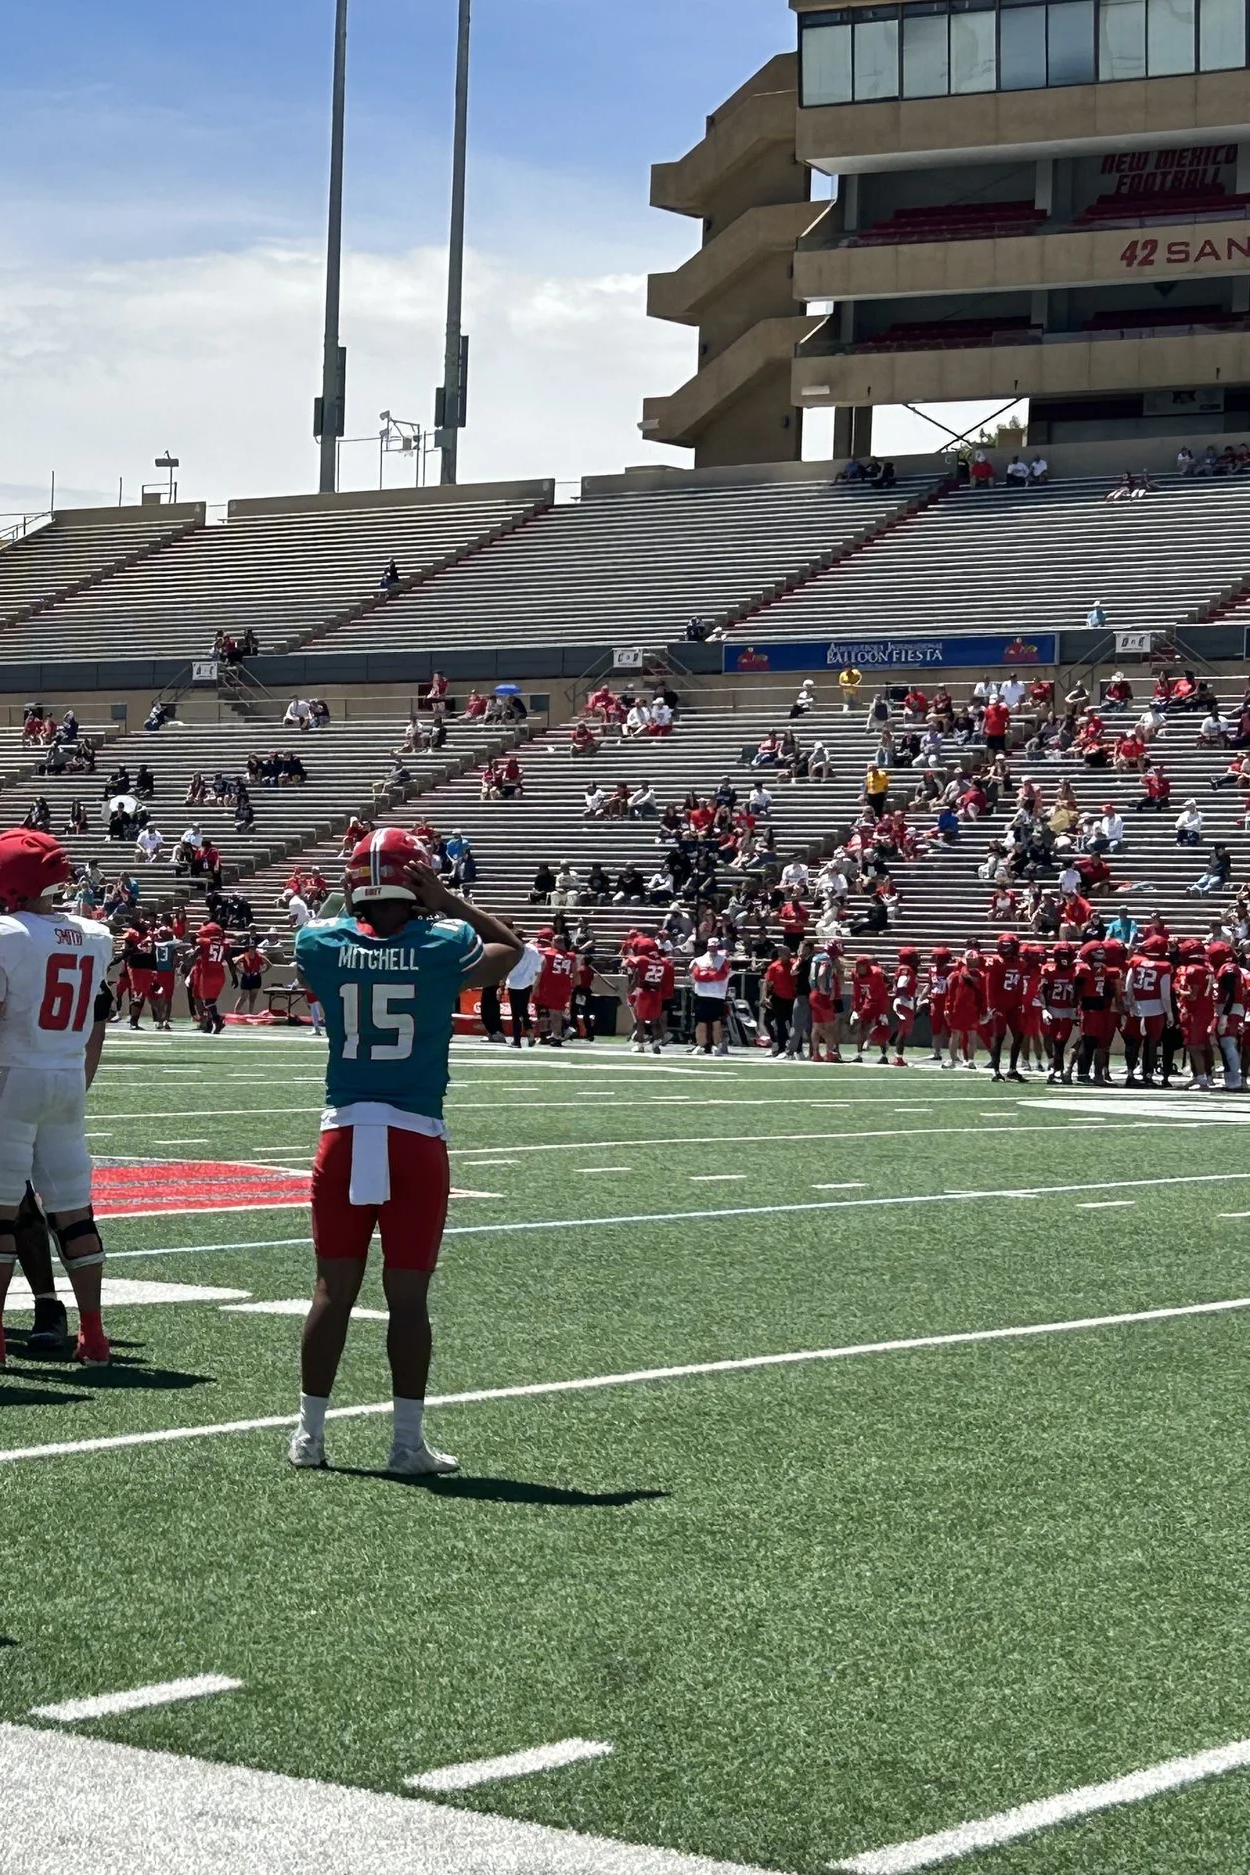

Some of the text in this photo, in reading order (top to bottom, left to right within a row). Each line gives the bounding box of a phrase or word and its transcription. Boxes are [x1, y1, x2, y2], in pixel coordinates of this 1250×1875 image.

[1101, 143, 1239, 175] NEW MEXICO
[1115, 166, 1221, 194] FOOTBALL
[1120, 239, 1159, 267] 42
[892, 648, 943, 662] FIESTA
[53, 927, 83, 946] SMITH
[208, 944, 224, 963] 51
[338, 943, 419, 971] MITCHELL
[645, 964, 665, 982] 22
[1133, 966, 1157, 991] 32
[38, 952, 95, 1032] 61
[339, 982, 415, 1061] 15
